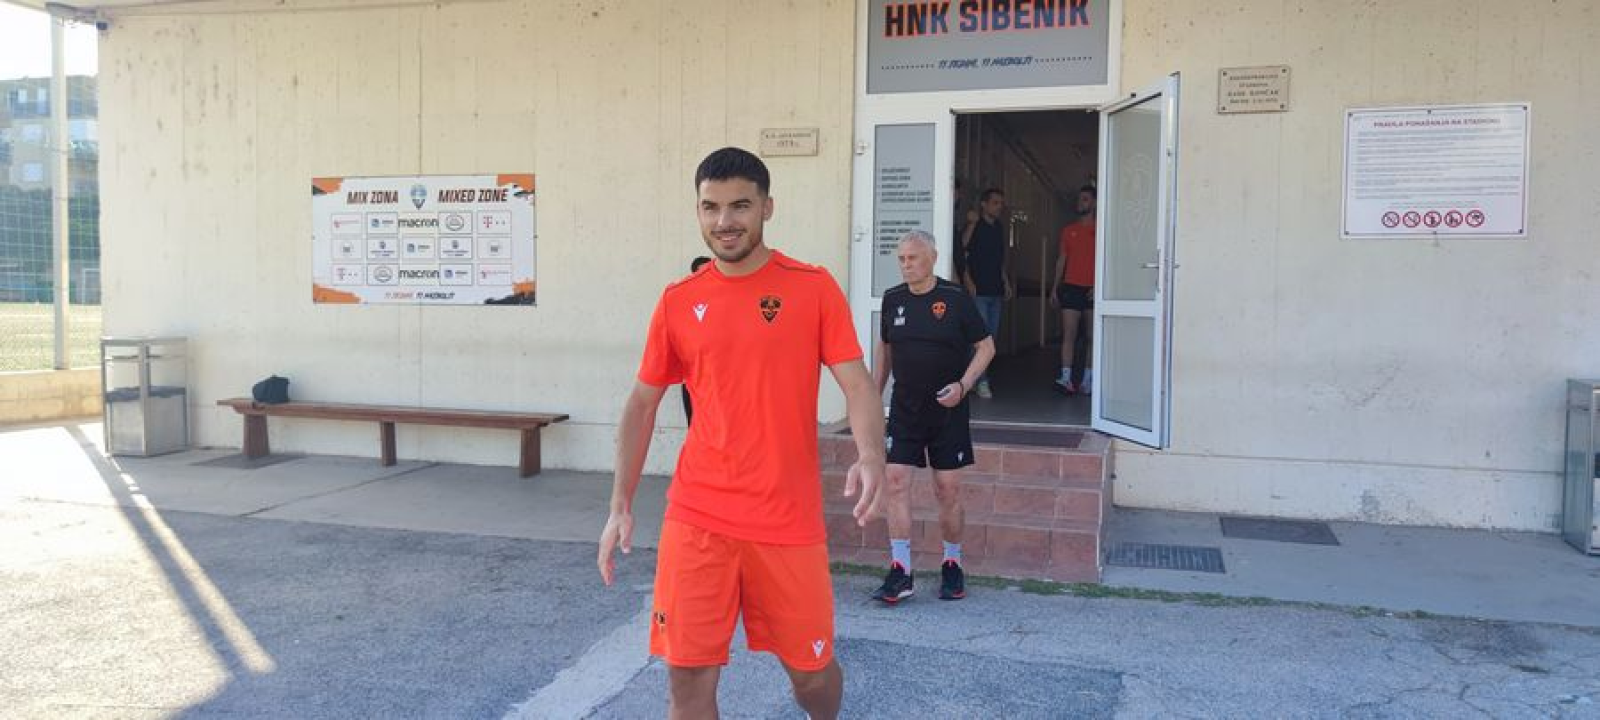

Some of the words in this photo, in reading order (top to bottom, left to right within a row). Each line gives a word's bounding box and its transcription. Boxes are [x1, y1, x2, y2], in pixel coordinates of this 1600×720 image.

[884, 2, 951, 39] HNK
[347, 190, 367, 204] MIX
[370, 190, 399, 204] ZONA
[438, 189, 475, 203] MIXED
[478, 188, 509, 203] ZONE
[398, 218, 439, 228] macron
[400, 269, 440, 279] macron
